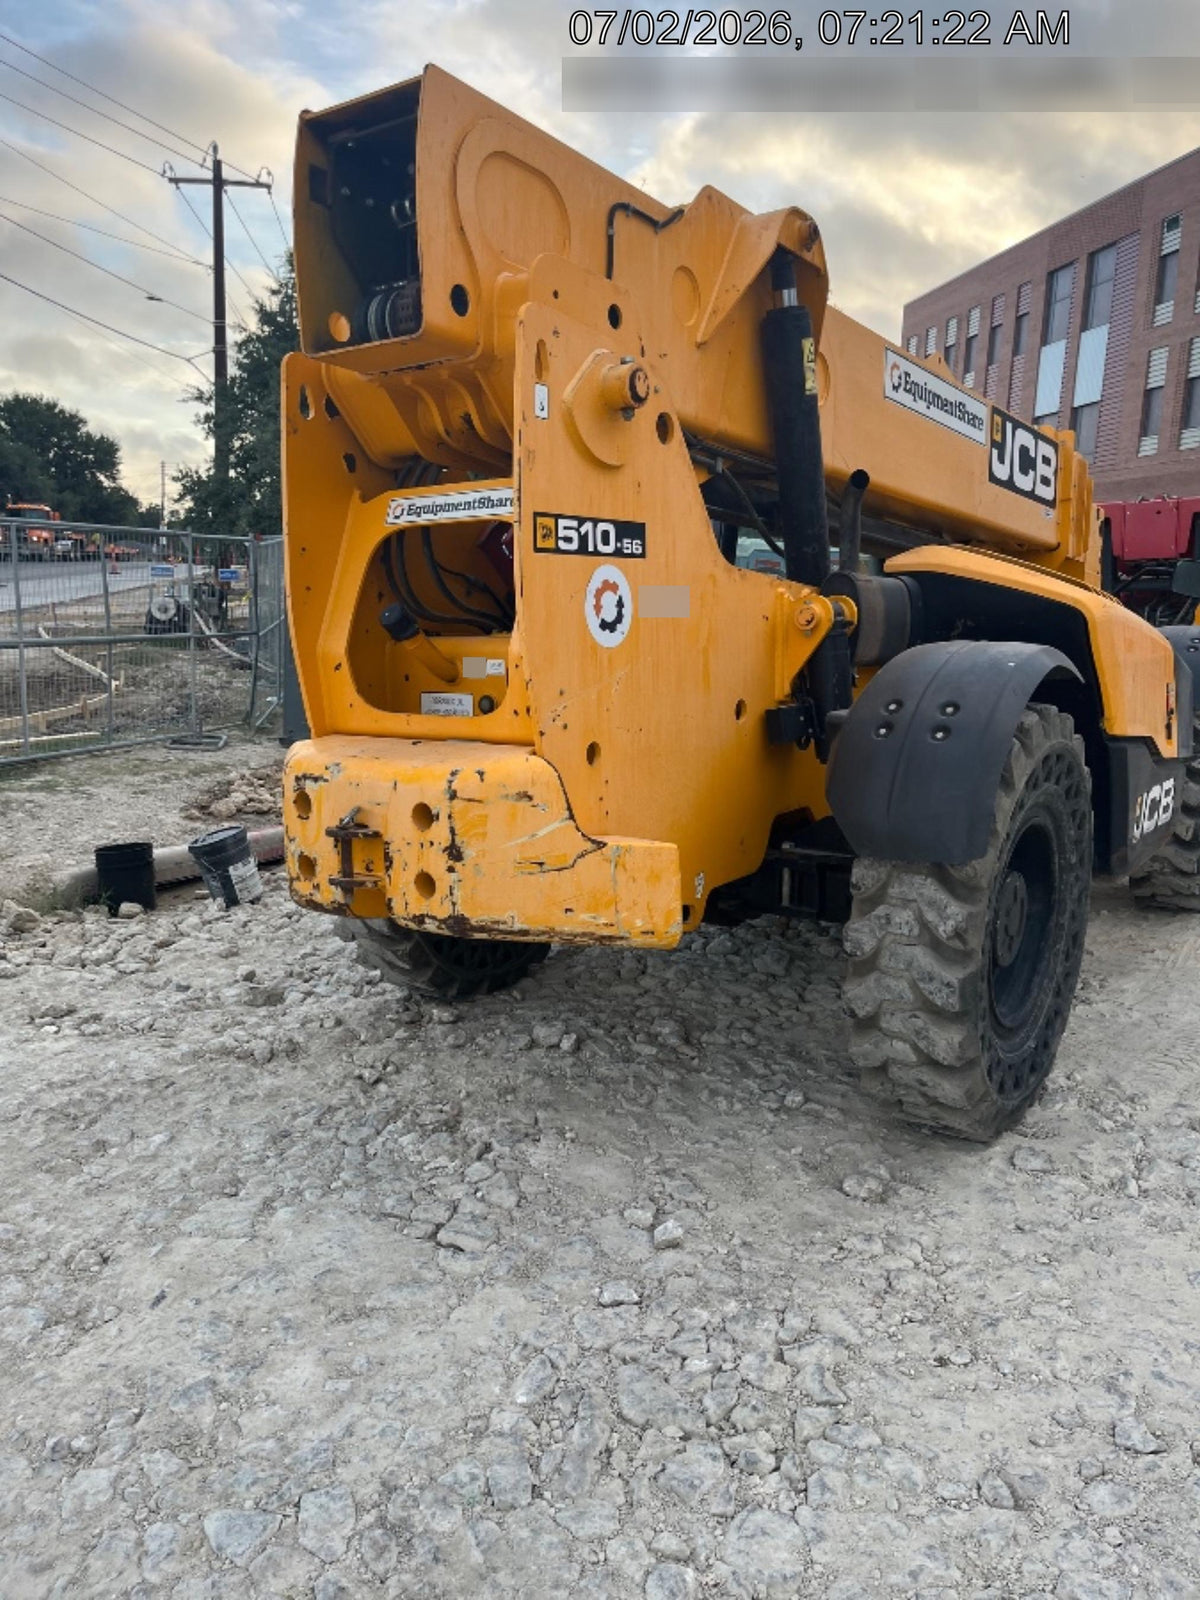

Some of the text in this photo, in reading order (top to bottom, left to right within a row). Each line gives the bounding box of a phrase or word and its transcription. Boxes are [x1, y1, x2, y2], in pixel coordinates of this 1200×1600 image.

[902, 370, 985, 432] EquipmentShare
[991, 420, 1057, 501] JCB
[1132, 778, 1175, 844] JCB
